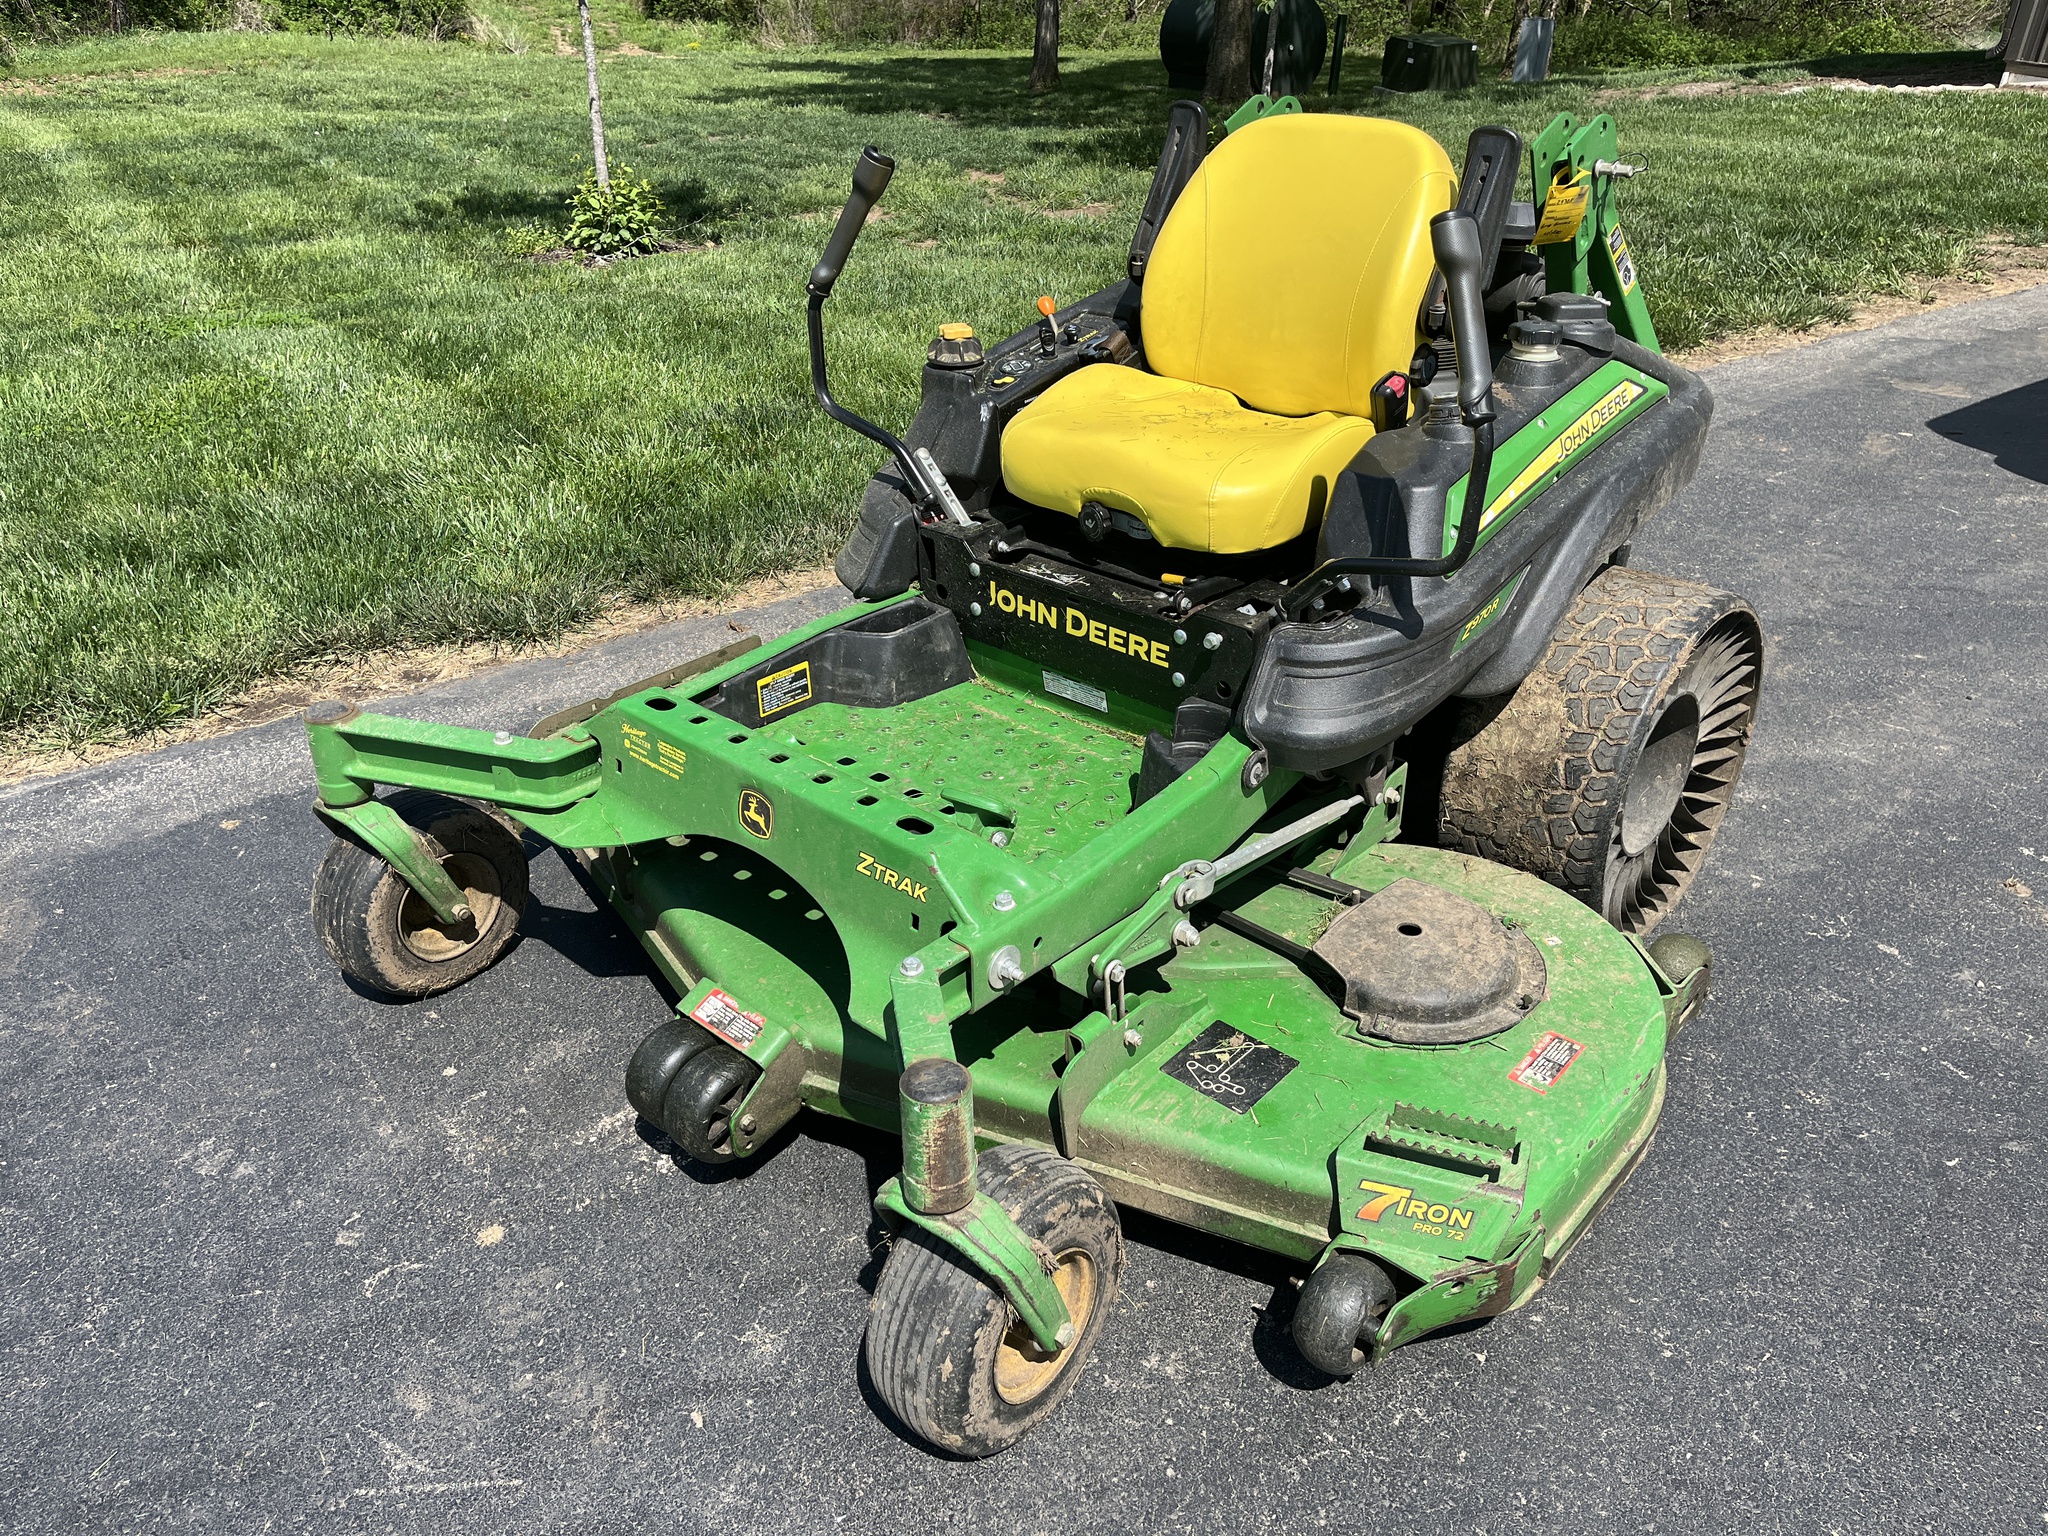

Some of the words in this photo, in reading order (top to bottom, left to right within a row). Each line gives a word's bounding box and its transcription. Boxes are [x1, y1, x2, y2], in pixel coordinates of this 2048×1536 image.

[1557, 422, 1590, 460] JOHN
[1591, 388, 1629, 430] DEERE
[989, 580, 1057, 629] JOHN
[1065, 606, 1170, 668] DEERE
[1461, 597, 1500, 642] Z970R
[855, 851, 929, 904] ZTRAK
[1412, 1222, 1443, 1237] PRO
[1446, 1229, 1465, 1242] 72
